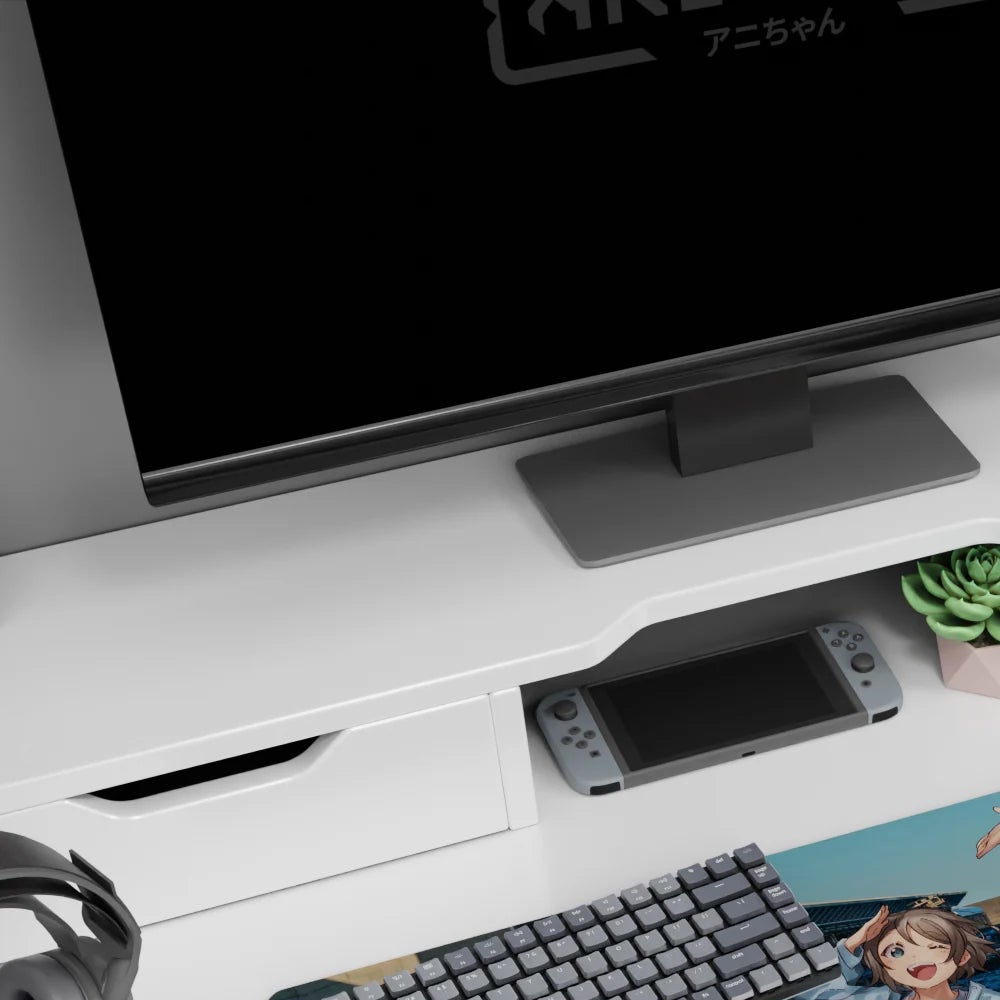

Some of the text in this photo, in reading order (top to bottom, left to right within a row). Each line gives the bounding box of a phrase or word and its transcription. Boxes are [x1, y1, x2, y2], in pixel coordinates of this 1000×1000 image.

[703, 7, 846, 58] アニちゃん
[771, 889, 787, 898] down
[731, 952, 744, 960] shift
